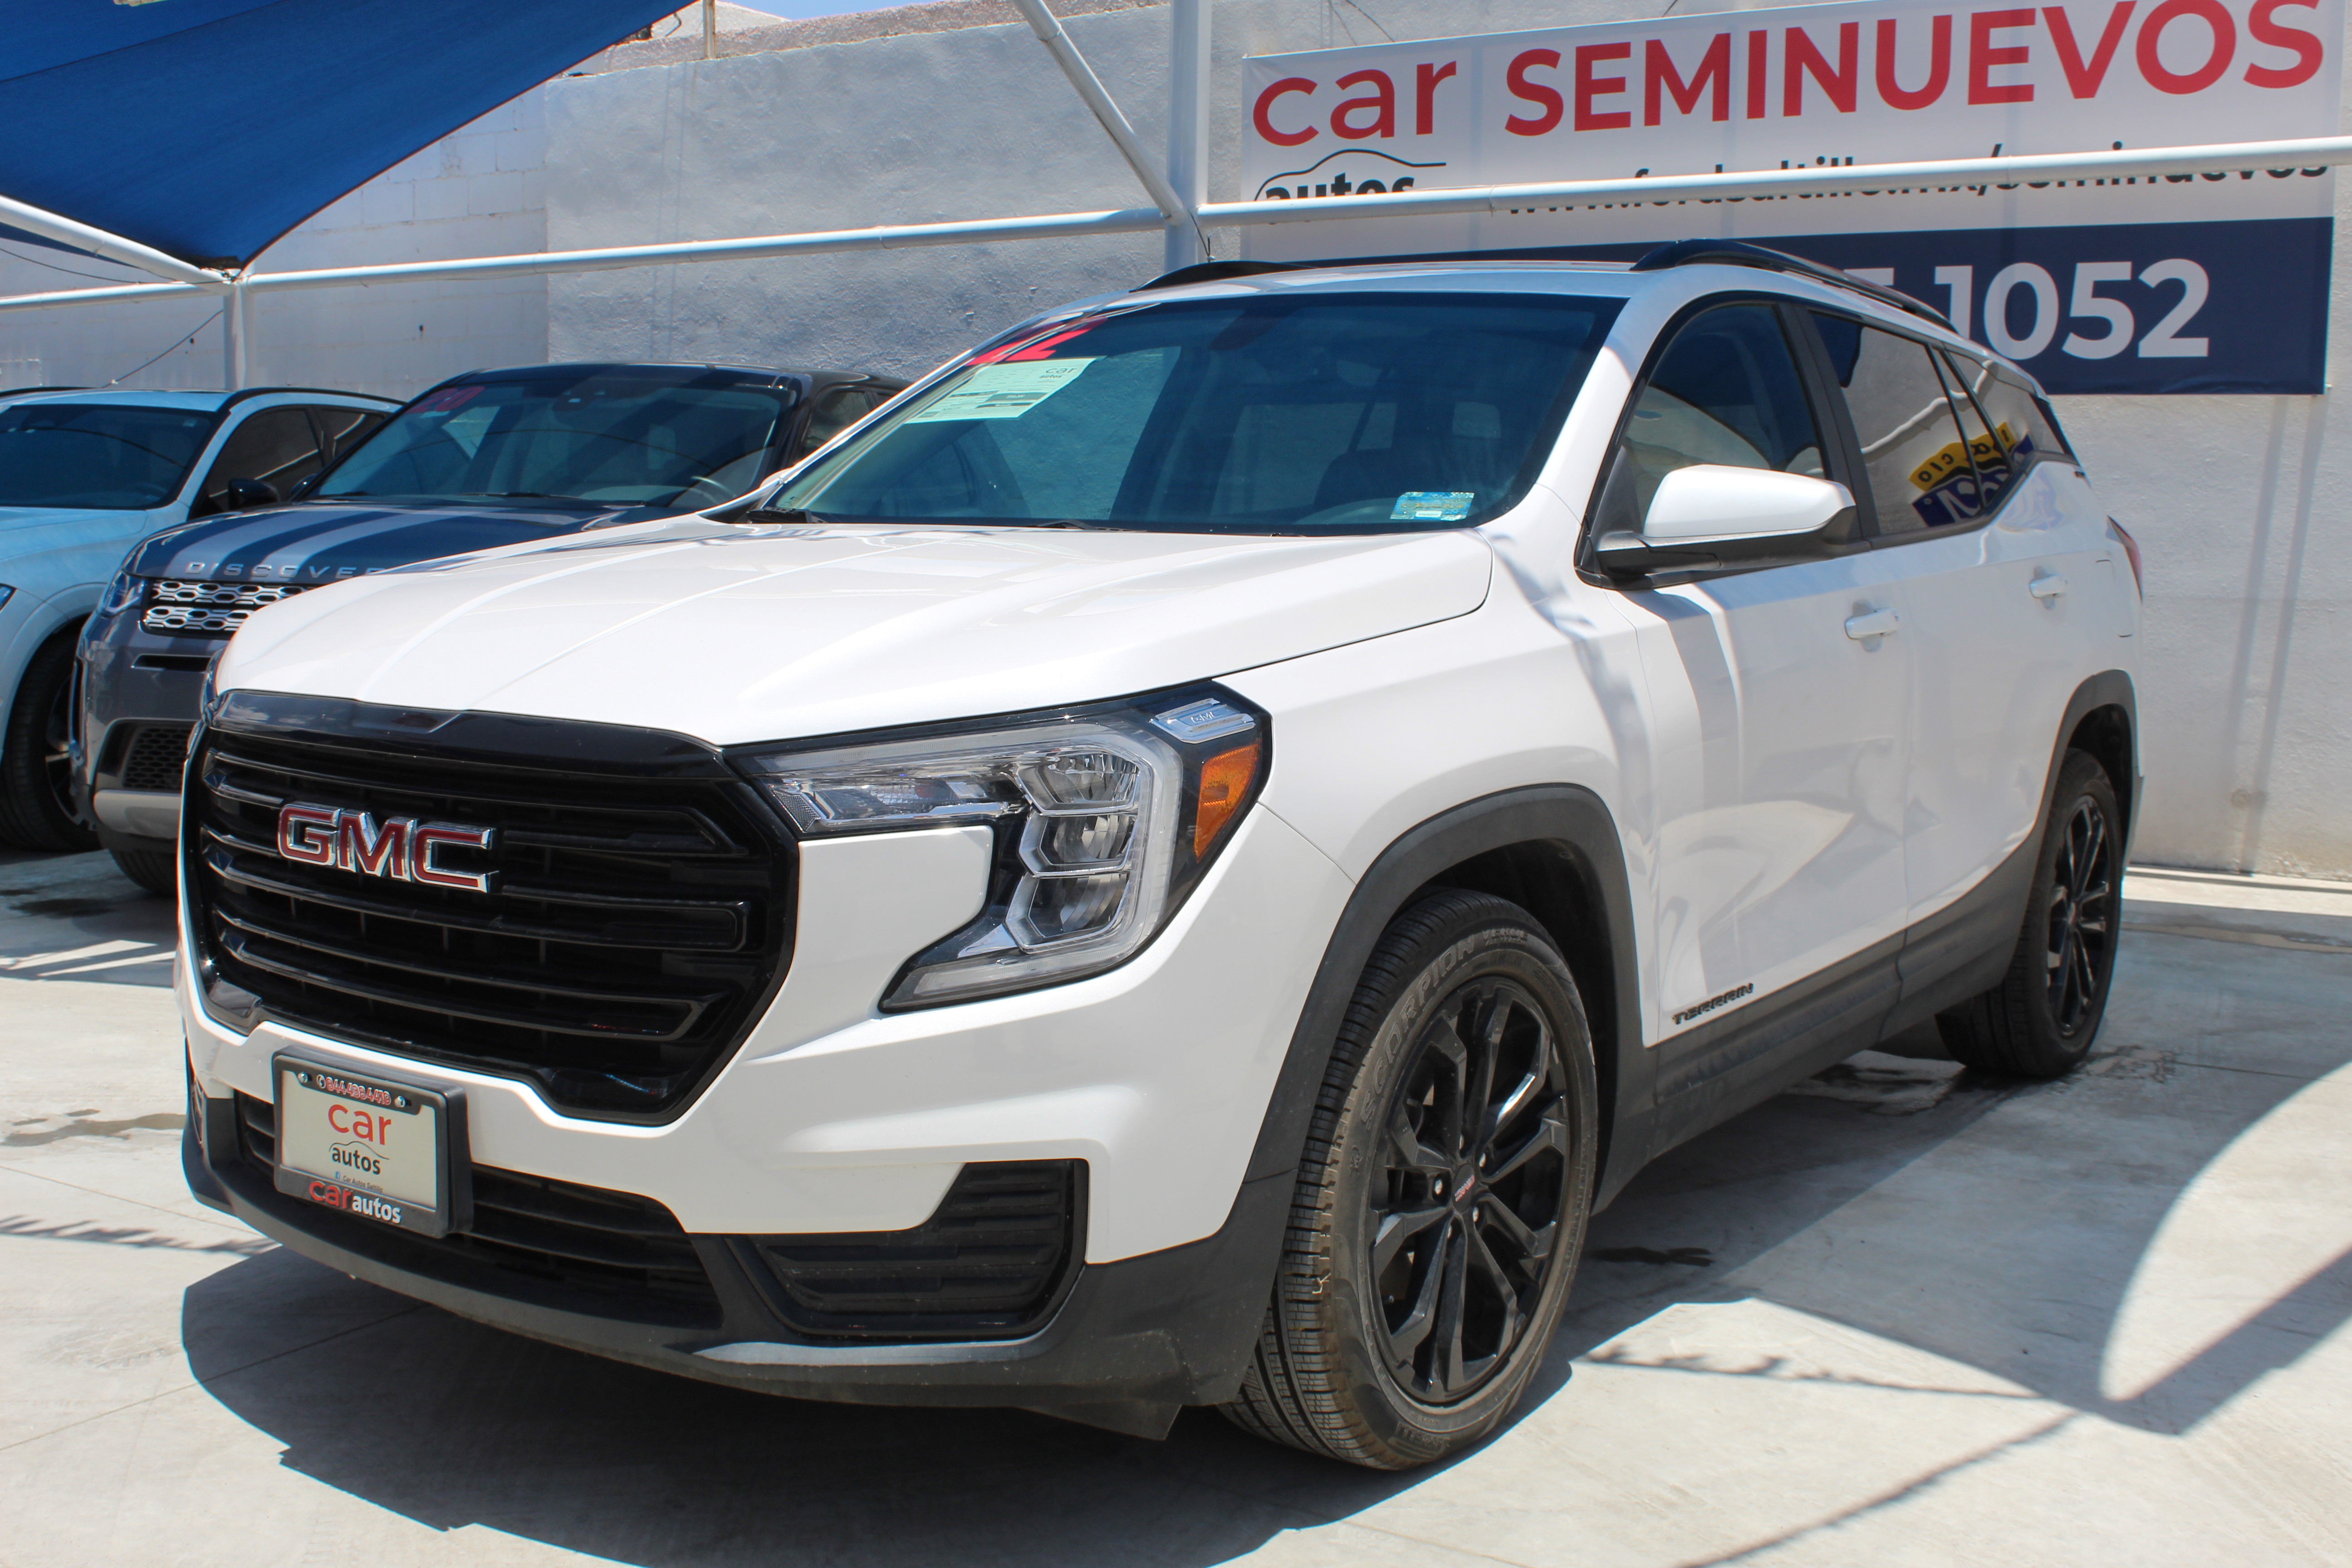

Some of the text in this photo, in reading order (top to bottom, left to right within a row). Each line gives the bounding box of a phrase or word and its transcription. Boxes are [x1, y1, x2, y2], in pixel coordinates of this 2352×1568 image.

[1253, 0, 2323, 147] car SEMINUEVOS
[1934, 259, 2210, 360] 1052
[1190, 710, 1223, 724] GMC
[276, 801, 499, 893] GMC
[1671, 982, 1754, 1025] TERRAIN
[328, 1104, 392, 1146] car
[332, 1147, 381, 1175] autos
